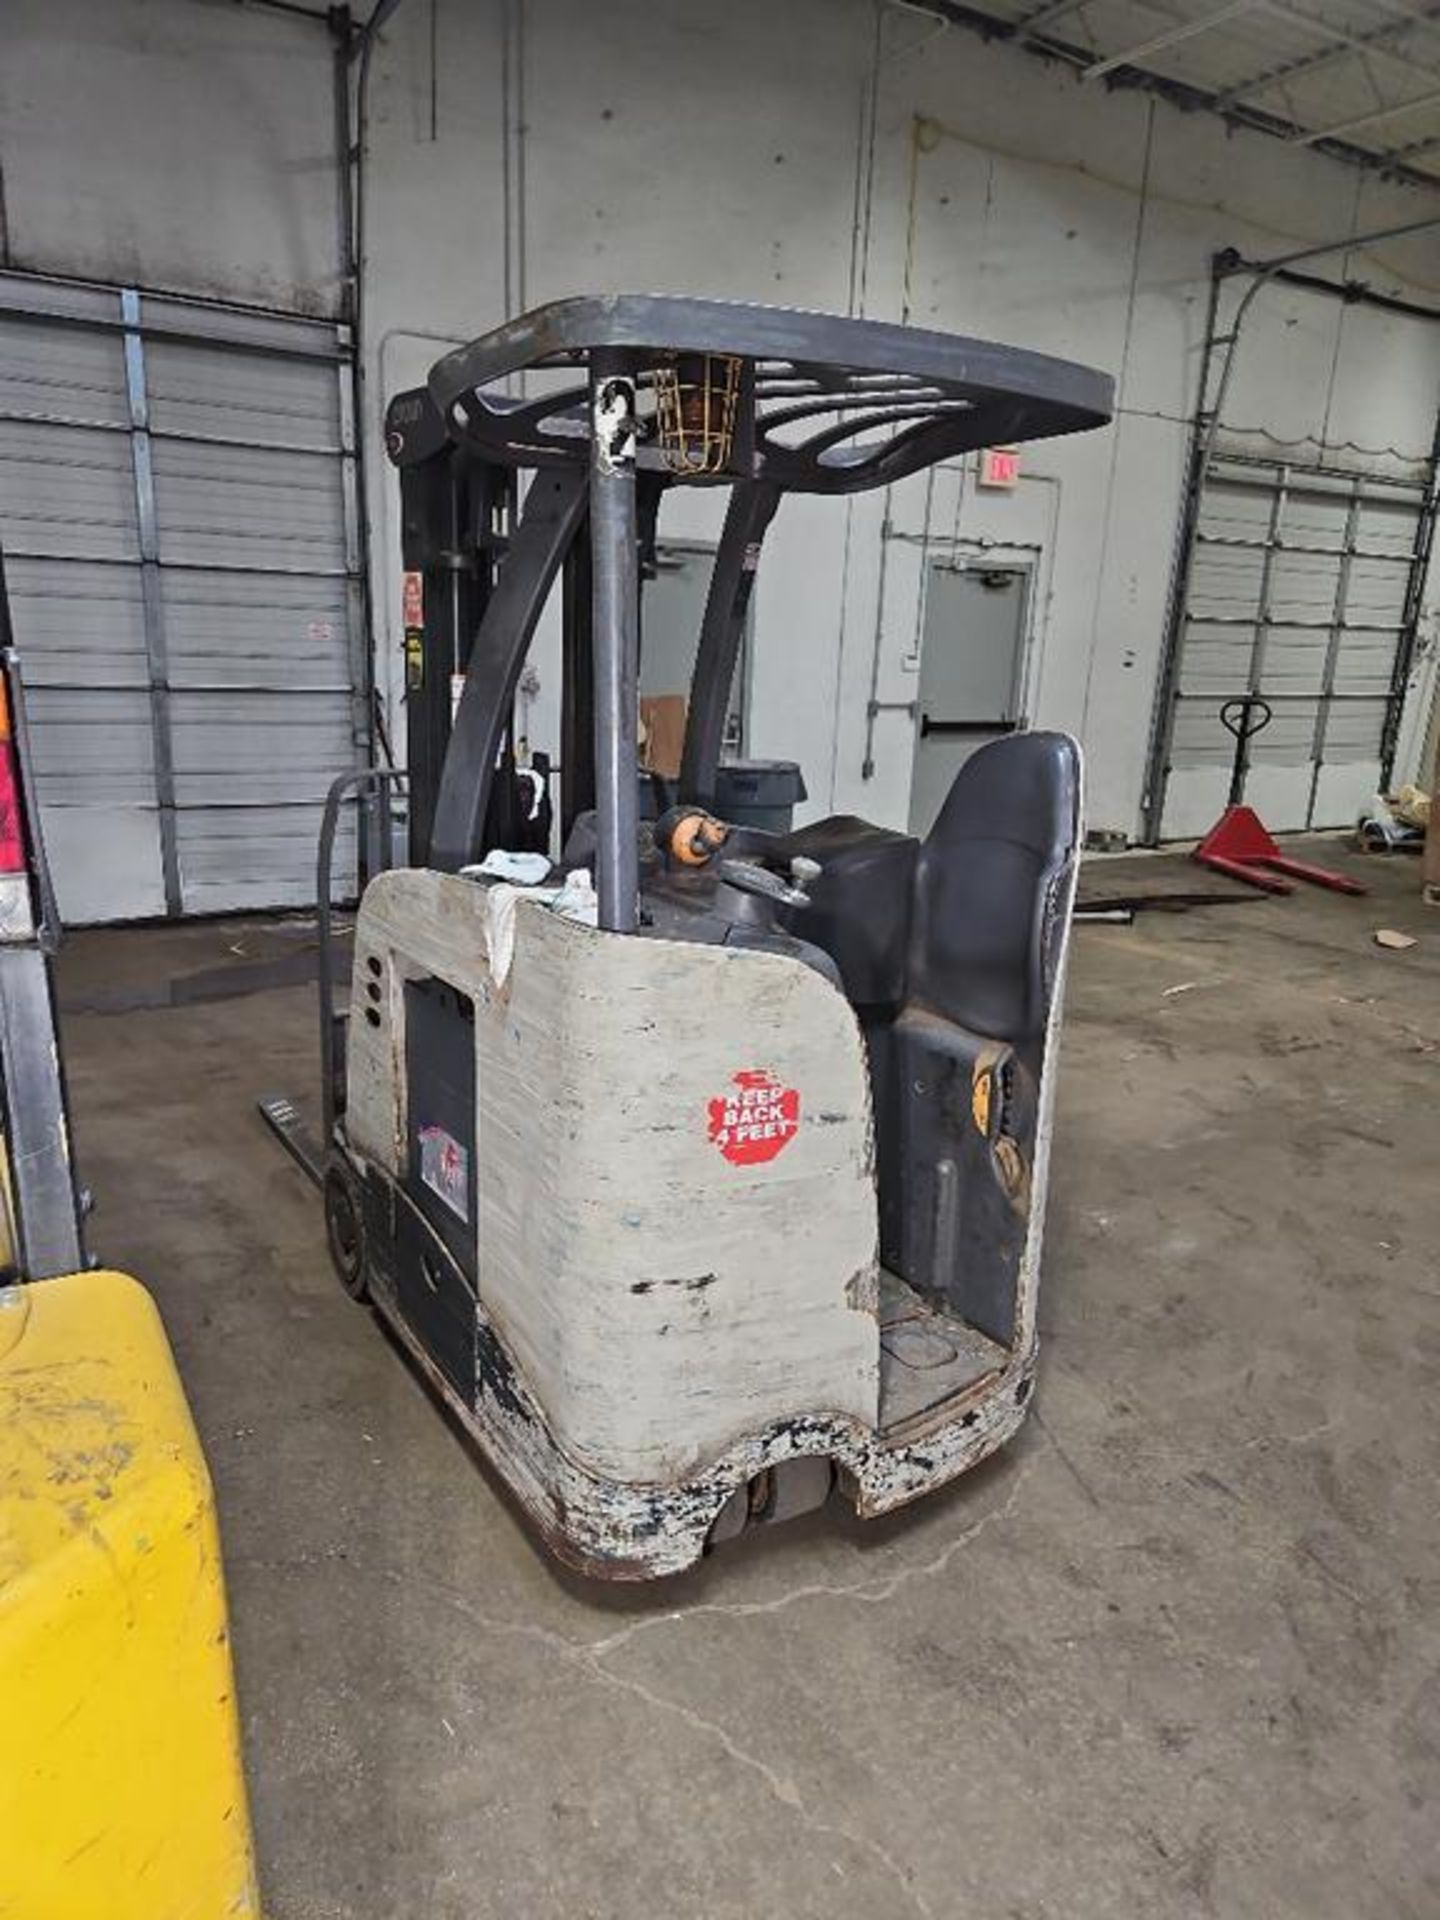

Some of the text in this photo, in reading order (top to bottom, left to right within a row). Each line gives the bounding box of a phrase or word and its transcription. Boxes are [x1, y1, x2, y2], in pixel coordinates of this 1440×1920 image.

[725, 1088, 783, 1108] KEEP
[724, 1105, 784, 1126] BACK
[717, 1121, 790, 1146] 4 FEET
